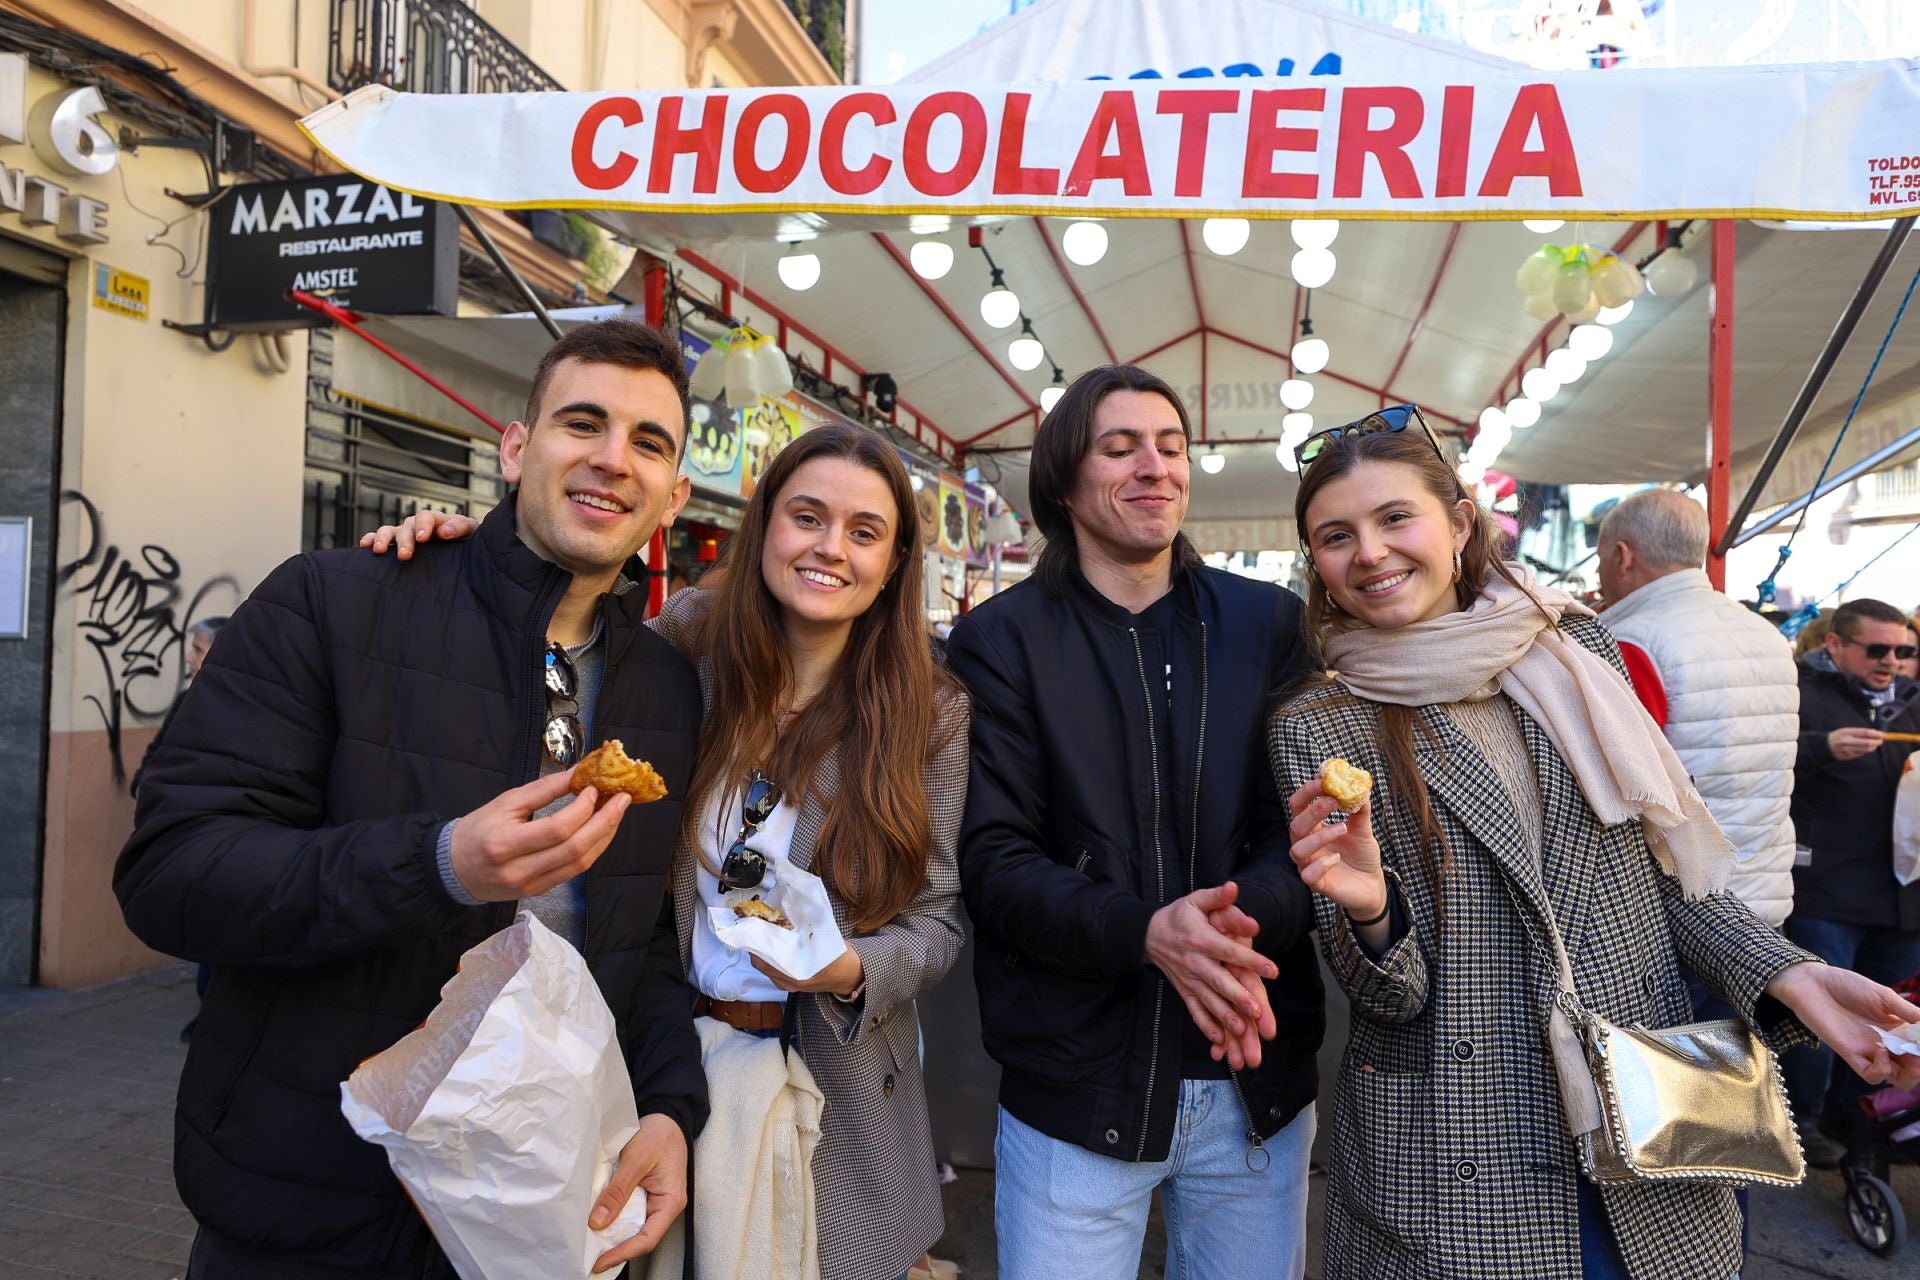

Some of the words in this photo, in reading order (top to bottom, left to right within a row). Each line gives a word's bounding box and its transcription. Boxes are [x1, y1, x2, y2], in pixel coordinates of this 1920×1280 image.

[571, 84, 1583, 199] CHOCOLATERIA
[230, 184, 425, 235] MARZAL
[279, 231, 423, 257] RESTAURANTE
[291, 267, 359, 291] AMSTEL
